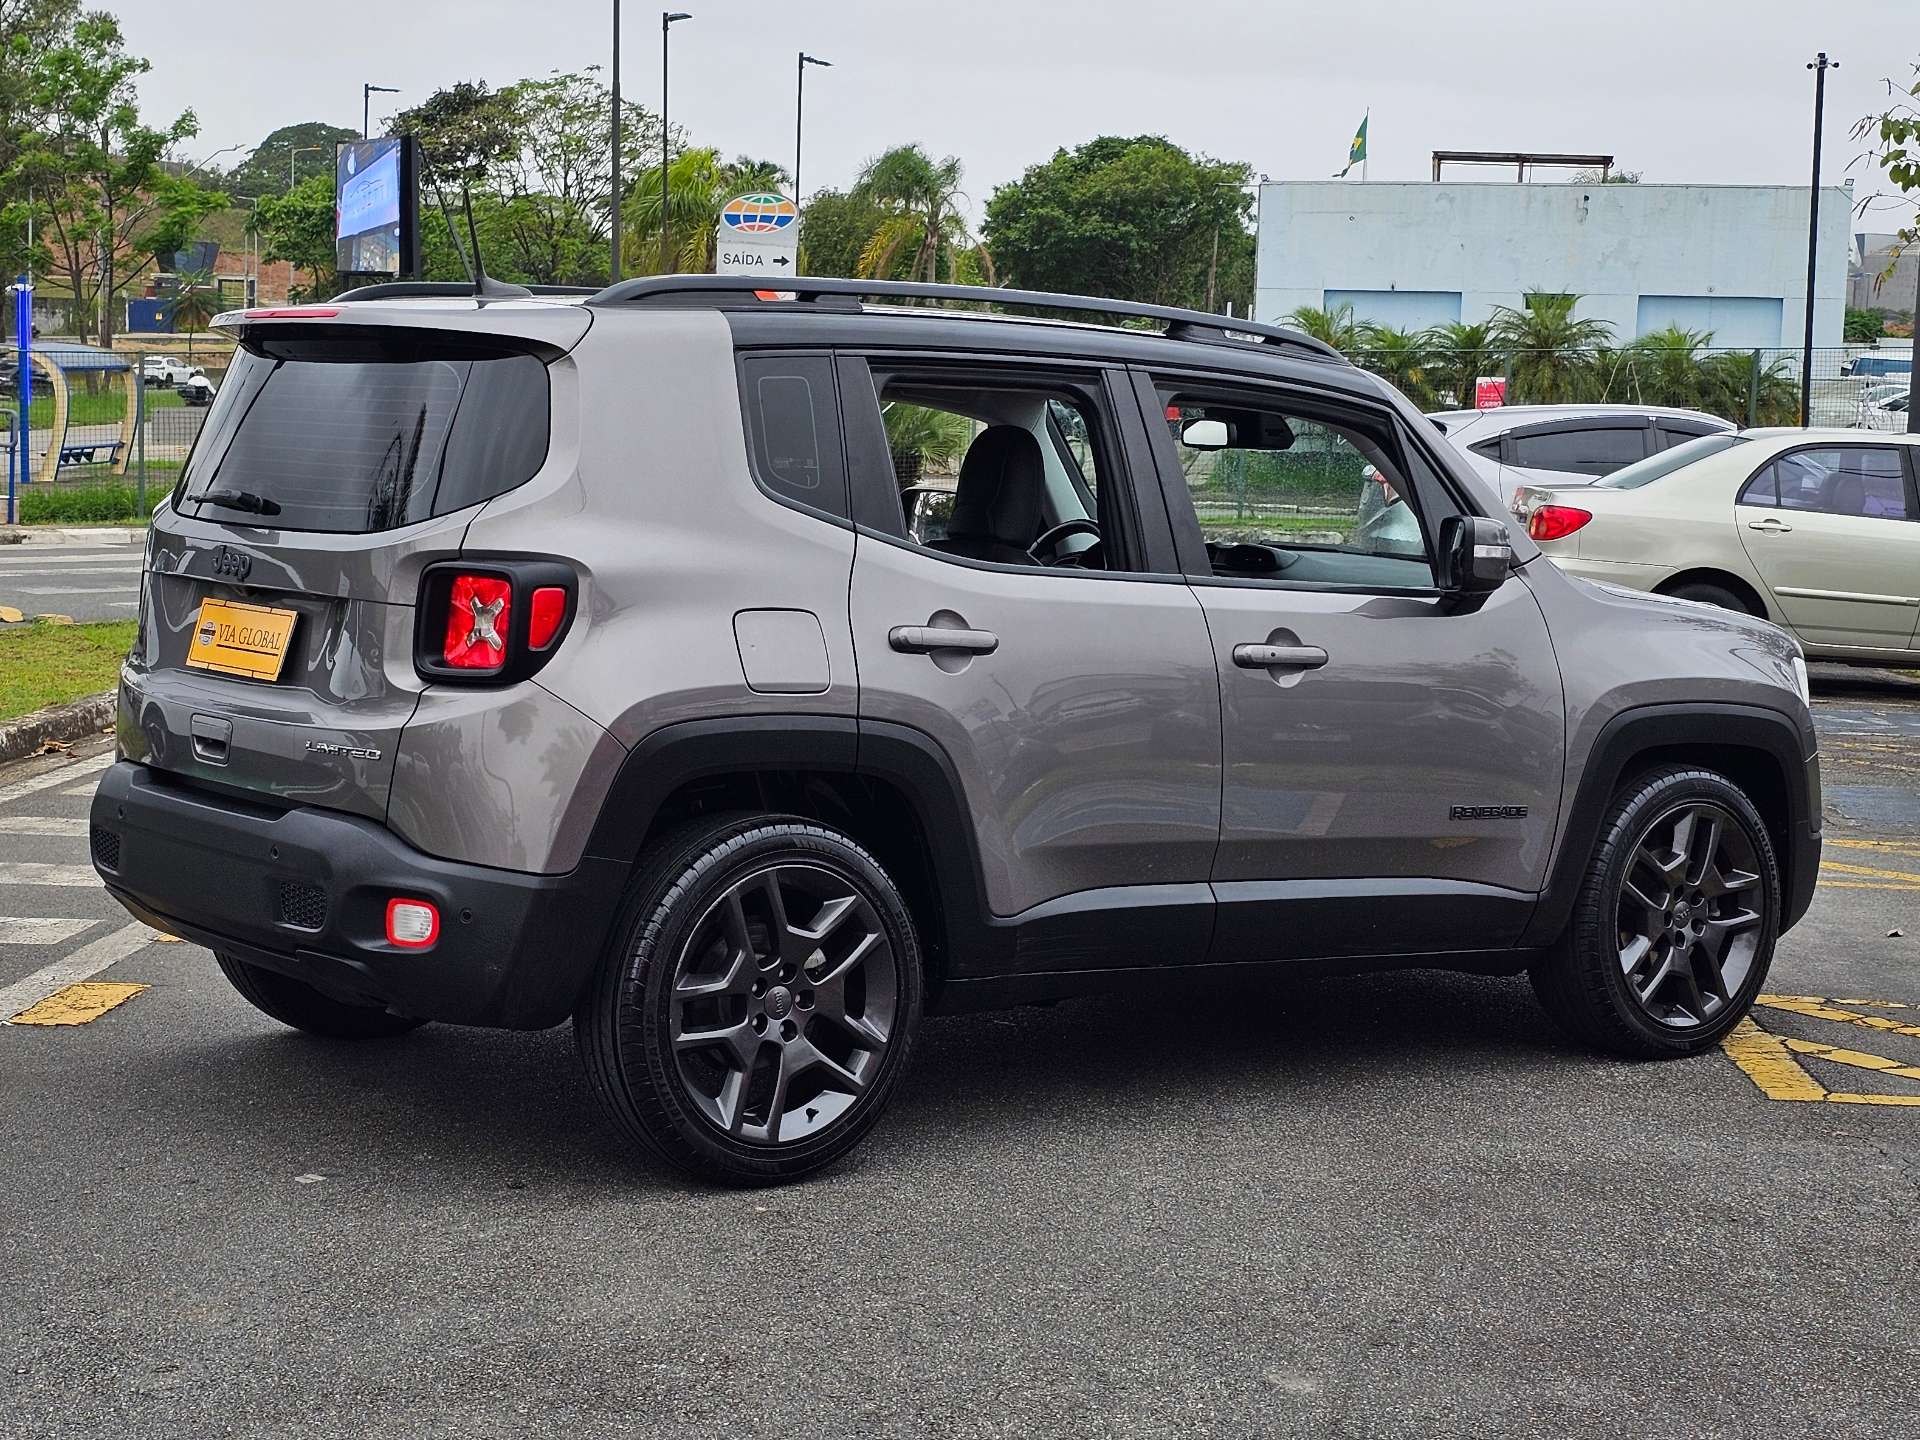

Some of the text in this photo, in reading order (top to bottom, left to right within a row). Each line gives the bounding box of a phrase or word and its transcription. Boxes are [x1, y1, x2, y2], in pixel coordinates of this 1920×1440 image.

[723, 252, 764, 266] SAÍDA
[211, 545, 252, 582] Jeep
[220, 624, 281, 650] VIA GLOBAL
[1450, 805, 1529, 820] RENEGADE
